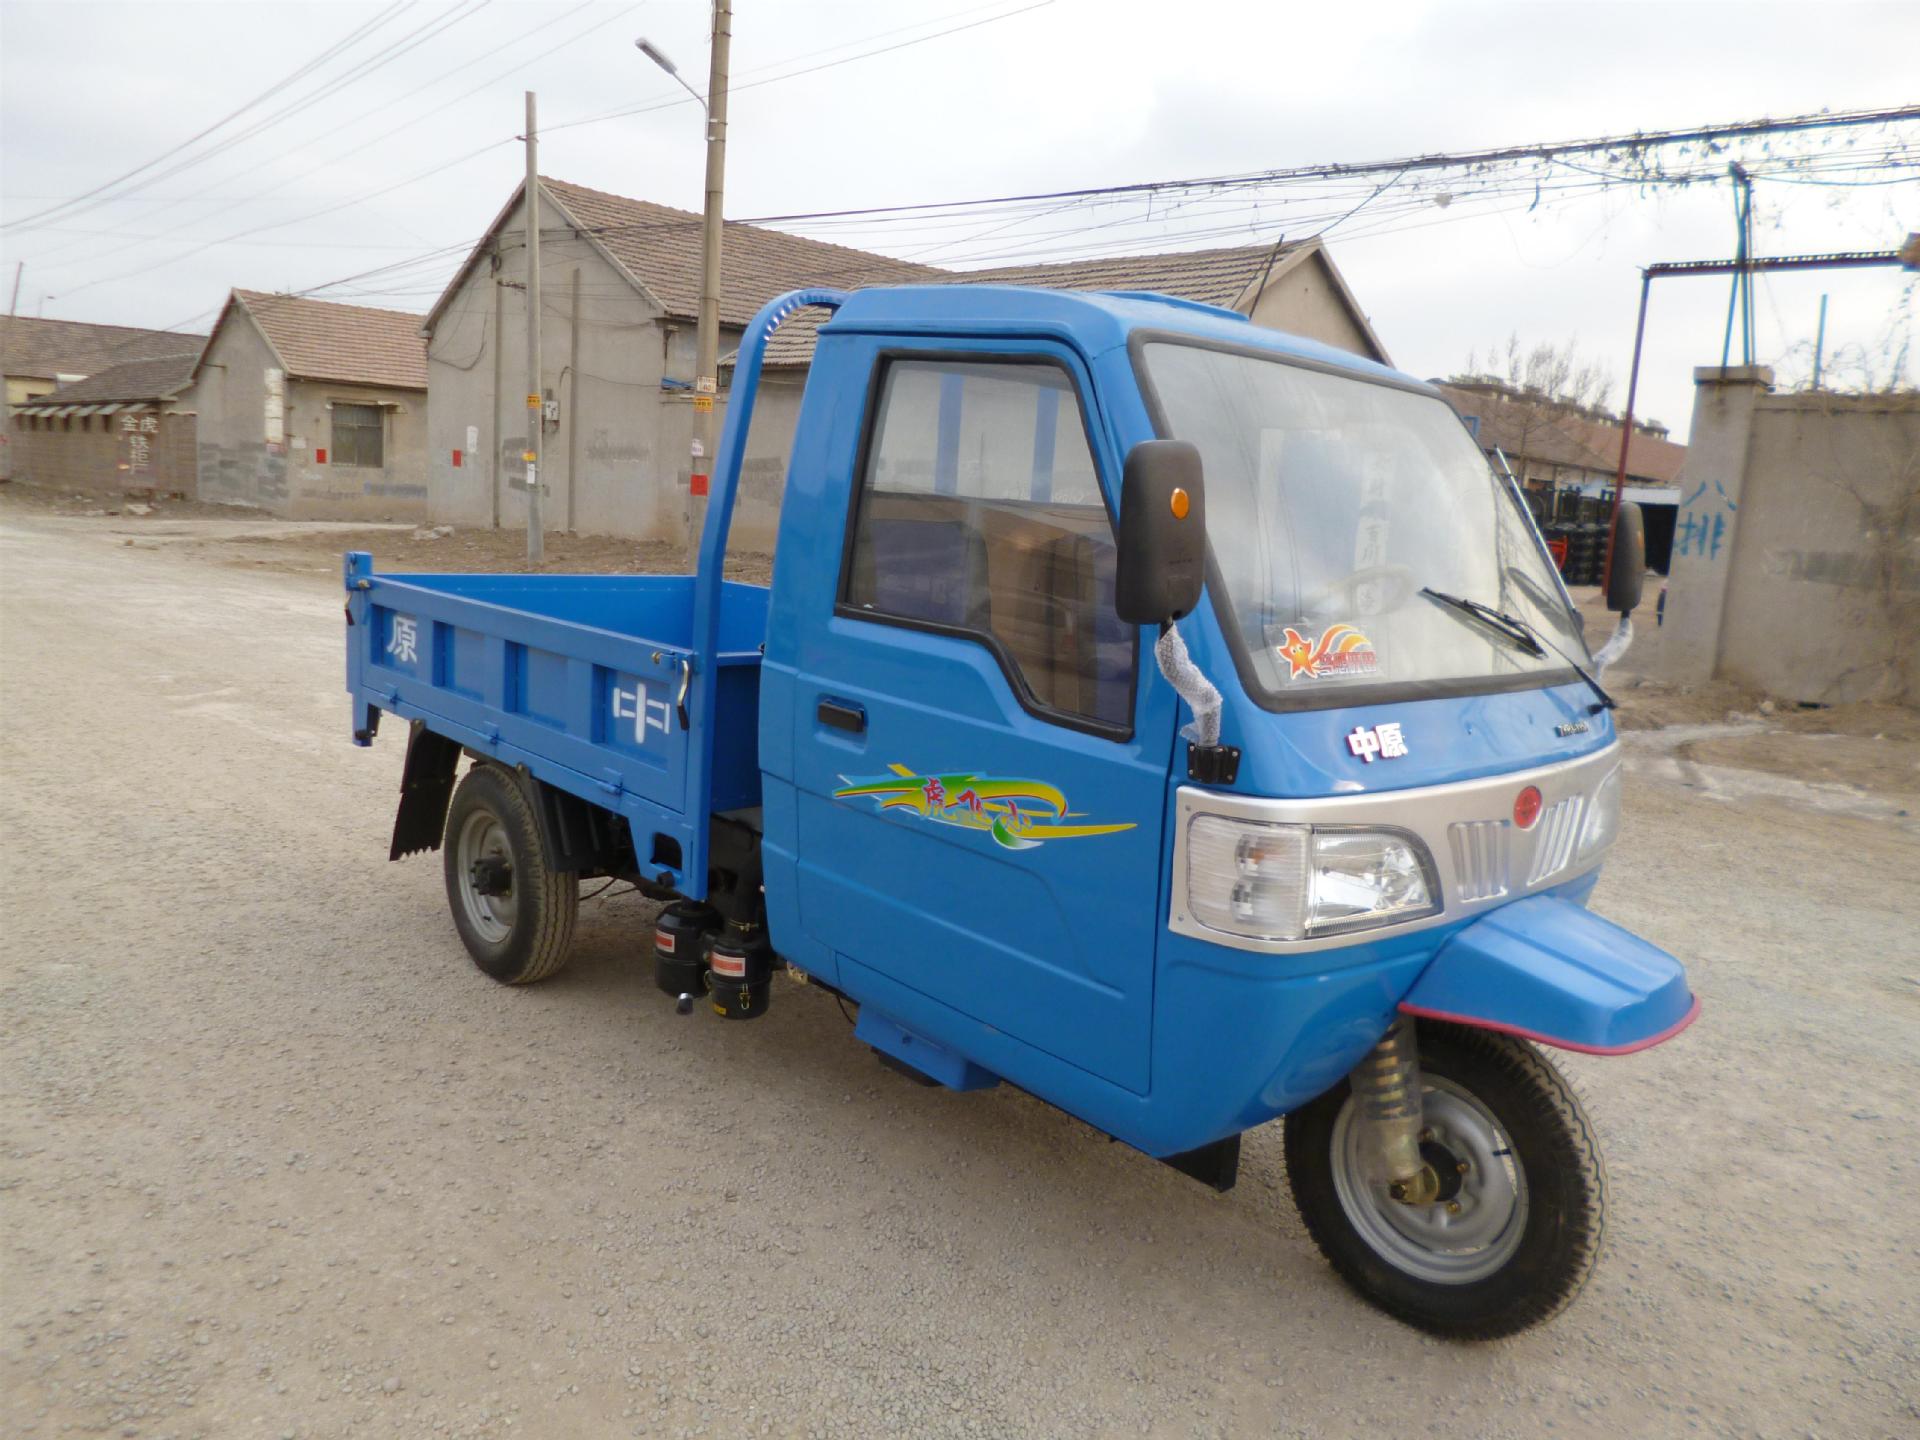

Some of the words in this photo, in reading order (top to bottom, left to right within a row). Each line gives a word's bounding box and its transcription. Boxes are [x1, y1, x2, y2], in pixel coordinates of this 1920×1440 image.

[386, 615, 418, 664] 原
[613, 682, 671, 744] 中
[1346, 722, 1408, 762] 中原
